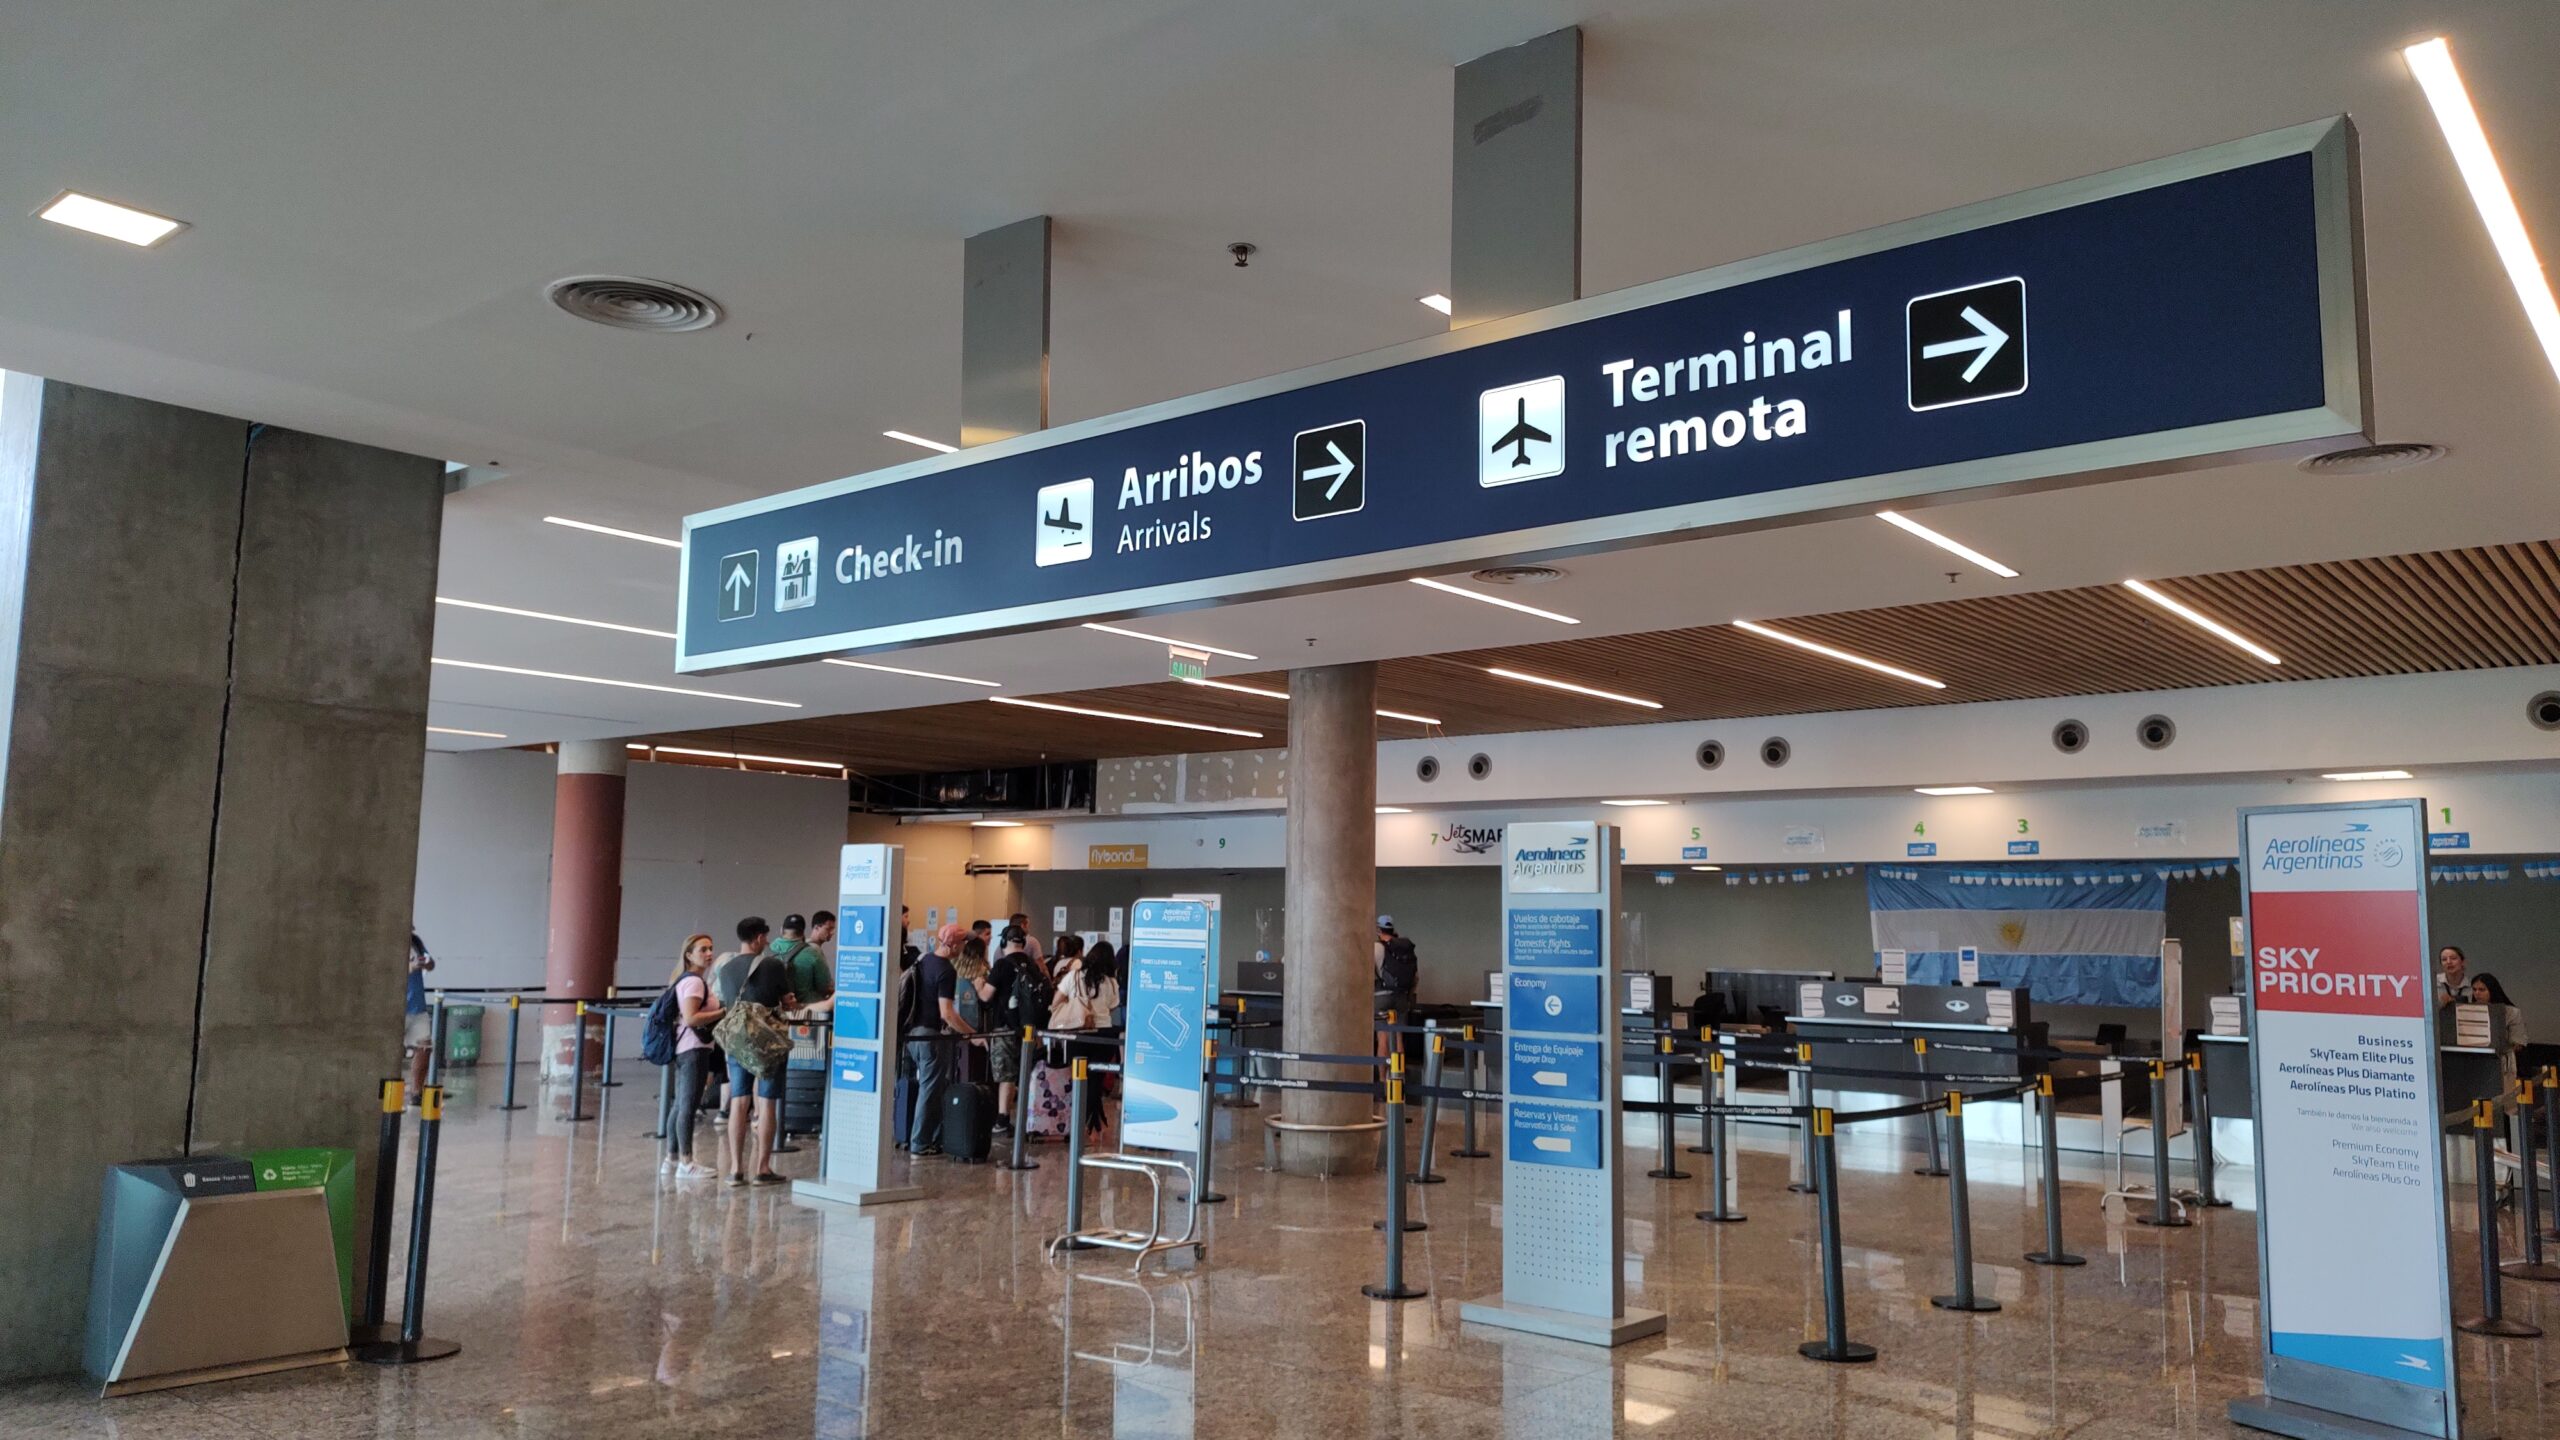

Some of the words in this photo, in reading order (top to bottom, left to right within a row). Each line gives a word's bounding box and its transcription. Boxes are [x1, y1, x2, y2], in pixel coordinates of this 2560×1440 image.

[1603, 309, 1853, 407] Terminal
[1605, 396, 1806, 468] remota
[1117, 445, 1263, 511] Arribos
[1116, 509, 1212, 554] Arrivals
[835, 528, 963, 585] Check-in
[2441, 807, 2451, 824] 1
[1691, 827, 1700, 840] 5
[1914, 821, 1925, 836] 4
[2017, 819, 2028, 833] 3
[1219, 838, 1226, 848] 9
[1431, 833, 1438, 845] 7
[2266, 835, 2366, 854] Aerolíneas
[1091, 849, 1135, 863] flybondi
[2262, 853, 2364, 874] Argentinas
[1513, 861, 1585, 878] Argentinas
[1514, 914, 1538, 923] Vuelos
[1538, 914, 1549, 923] de
[1549, 914, 1580, 924] cabotaje
[1514, 939, 1547, 948] Domestic
[1548, 939, 1572, 950] flights
[2258, 946, 2320, 969] SKY
[1514, 978, 1547, 989] Economy
[2260, 971, 2410, 998] PRIORITY
[1514, 1041, 1542, 1054] Entrega
[1543, 1043, 1552, 1053] de
[1553, 1044, 1584, 1058] Equipaje
[2358, 1035, 2413, 1049] Business
[1541, 1055, 1556, 1065] Drop
[2310, 1048, 2359, 1062] SkyTeam
[2362, 1051, 2387, 1063] Elite
[2389, 1053, 2414, 1065] Plus
[2279, 1062, 2335, 1077] Aerolíneas
[2337, 1066, 2360, 1079] Plus
[2362, 1068, 2415, 1083] Diamante
[2290, 1079, 2346, 1095] Aerolíneas
[2348, 1084, 2372, 1096] Plus
[2374, 1086, 2416, 1100] Platino
[1514, 1108, 1546, 1120] Reservas
[1553, 1110, 1579, 1122] Ventas
[2297, 1108, 2327, 1118] También
[2336, 1111, 2361, 1120] damos
[2362, 1113, 2369, 1121] la
[2371, 1115, 2411, 1126] bienvenida
[1514, 1120, 1552, 1131] Reservations
[1560, 1123, 1576, 1133] Sales
[2332, 1139, 2373, 1152] Premium
[2376, 1143, 2419, 1159] Economy
[2352, 1155, 2394, 1168] SkyTeam
[2397, 1160, 2420, 1172] Elite
[2333, 1167, 2379, 1182] Aerolíneas
[2381, 1172, 2402, 1185] Plus
[2404, 1175, 2421, 1187] Oro
